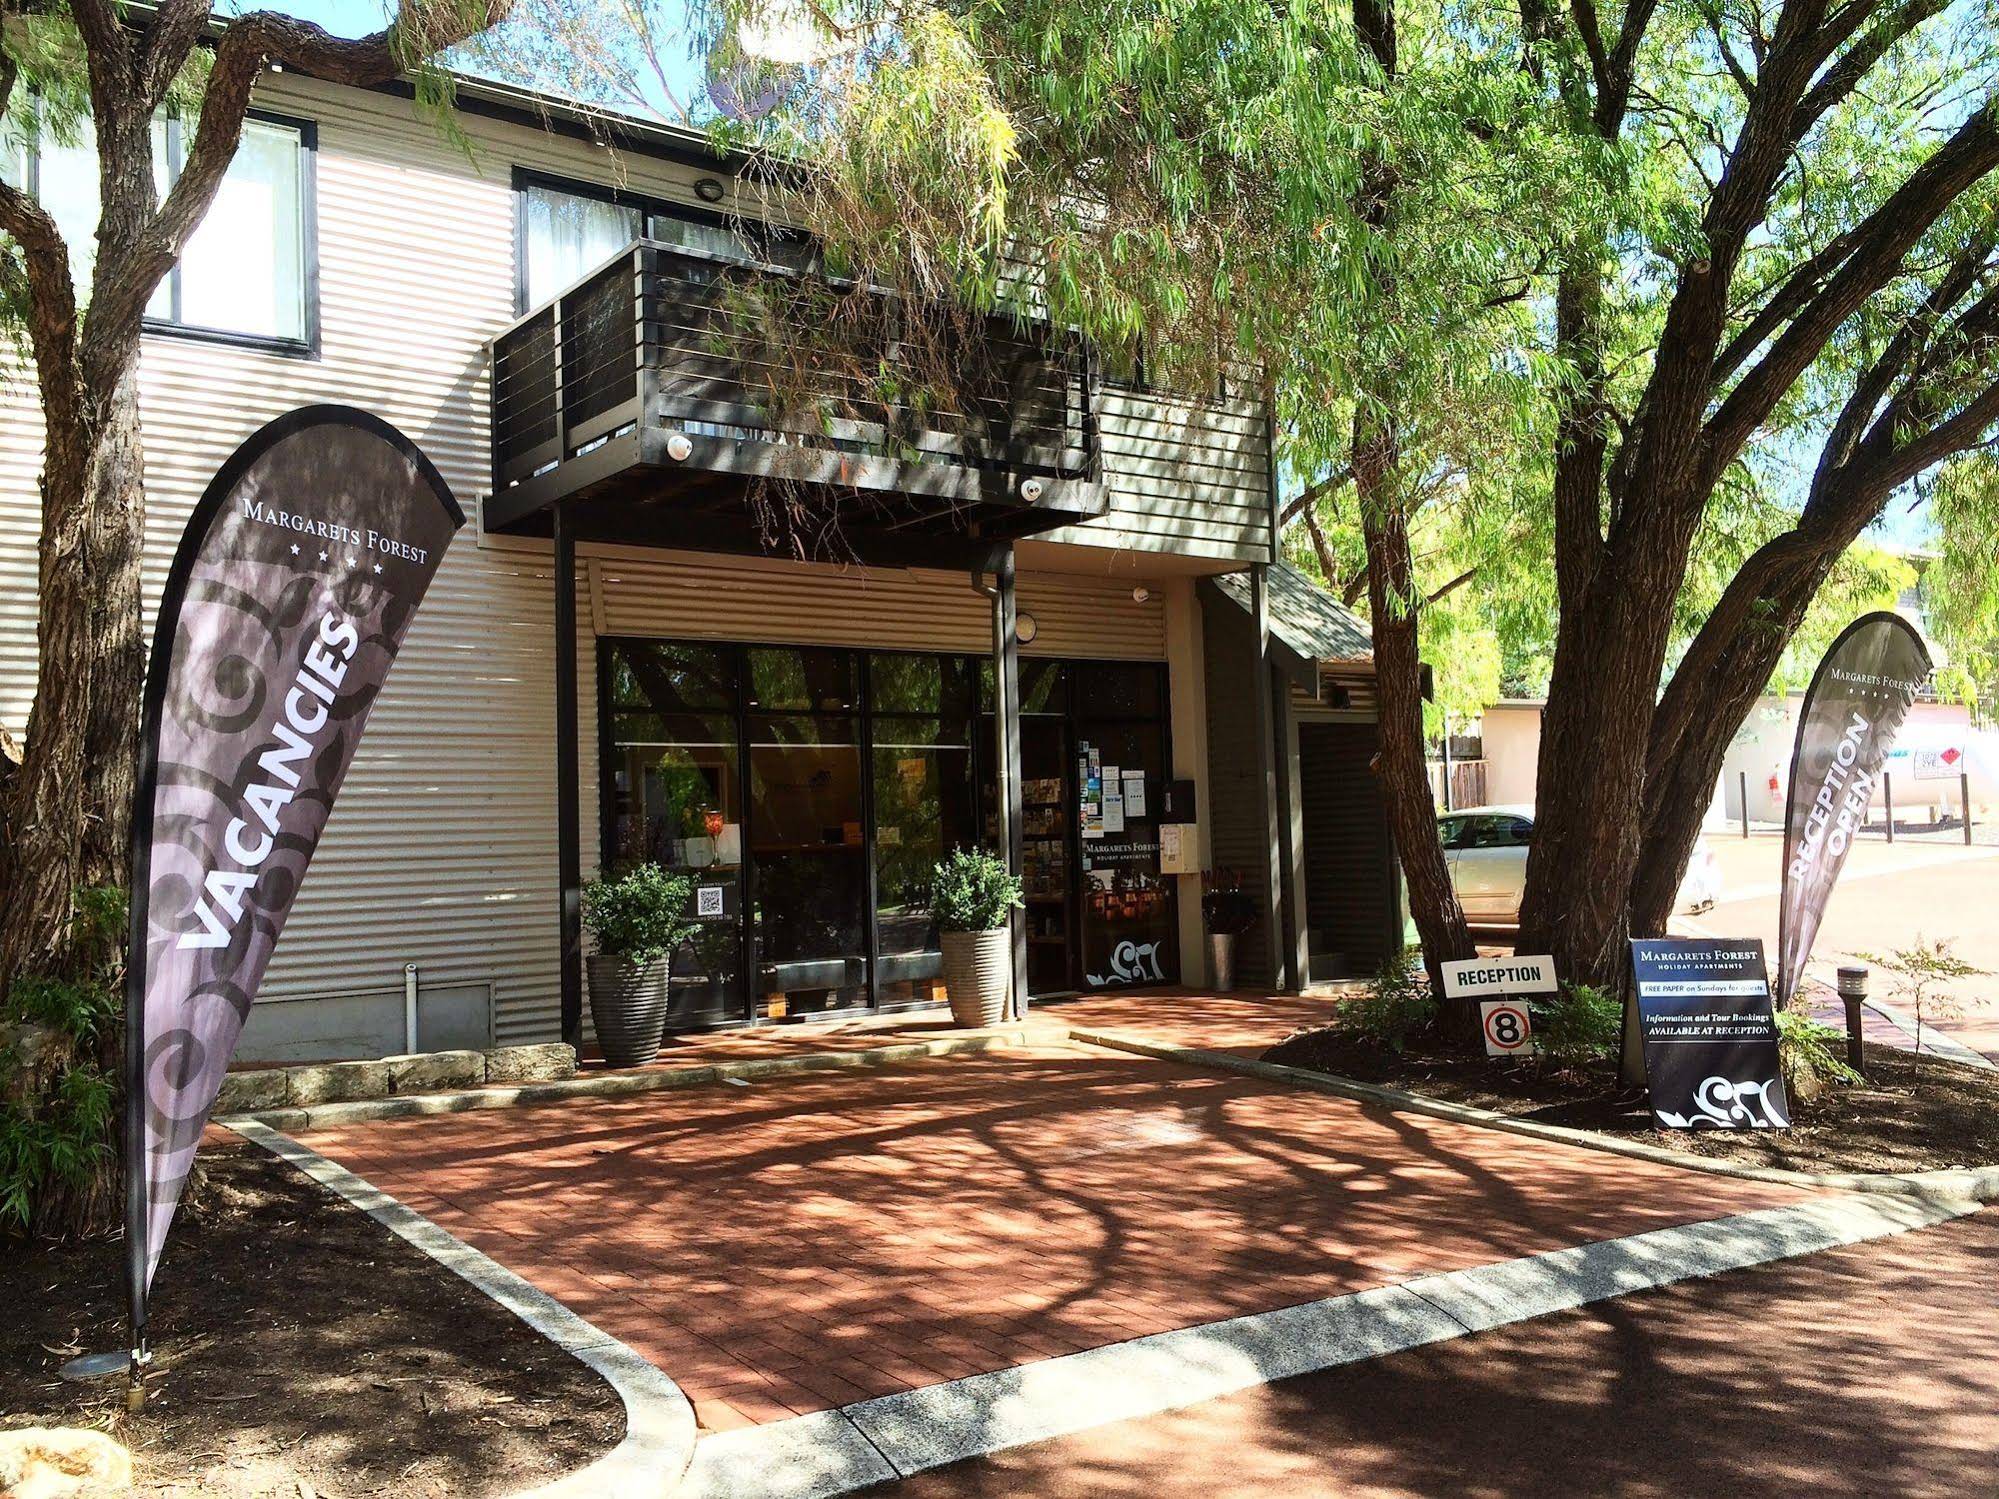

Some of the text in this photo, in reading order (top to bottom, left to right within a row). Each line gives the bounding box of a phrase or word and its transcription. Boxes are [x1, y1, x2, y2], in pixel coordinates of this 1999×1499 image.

[242, 498, 428, 565] MARGARETS FOREST
[1831, 668, 1914, 691] MARGARETS FOREST
[176, 609, 359, 950] VACANCIES
[1787, 711, 1870, 882] RECEPTION
[1827, 767, 1873, 856] OPEN
[1086, 844, 1132, 853] MARGARETS
[1640, 949, 1758, 962] MARGARETS FOREST
[1457, 967, 1541, 986] RECEPTION
[1697, 984, 1727, 993] Sundays
[1494, 1012, 1520, 1043] 8
[1646, 1013, 1769, 1023] Information and Tour Bookings
[1648, 1026, 1770, 1036] AVAILABLE AT RECEPTION
